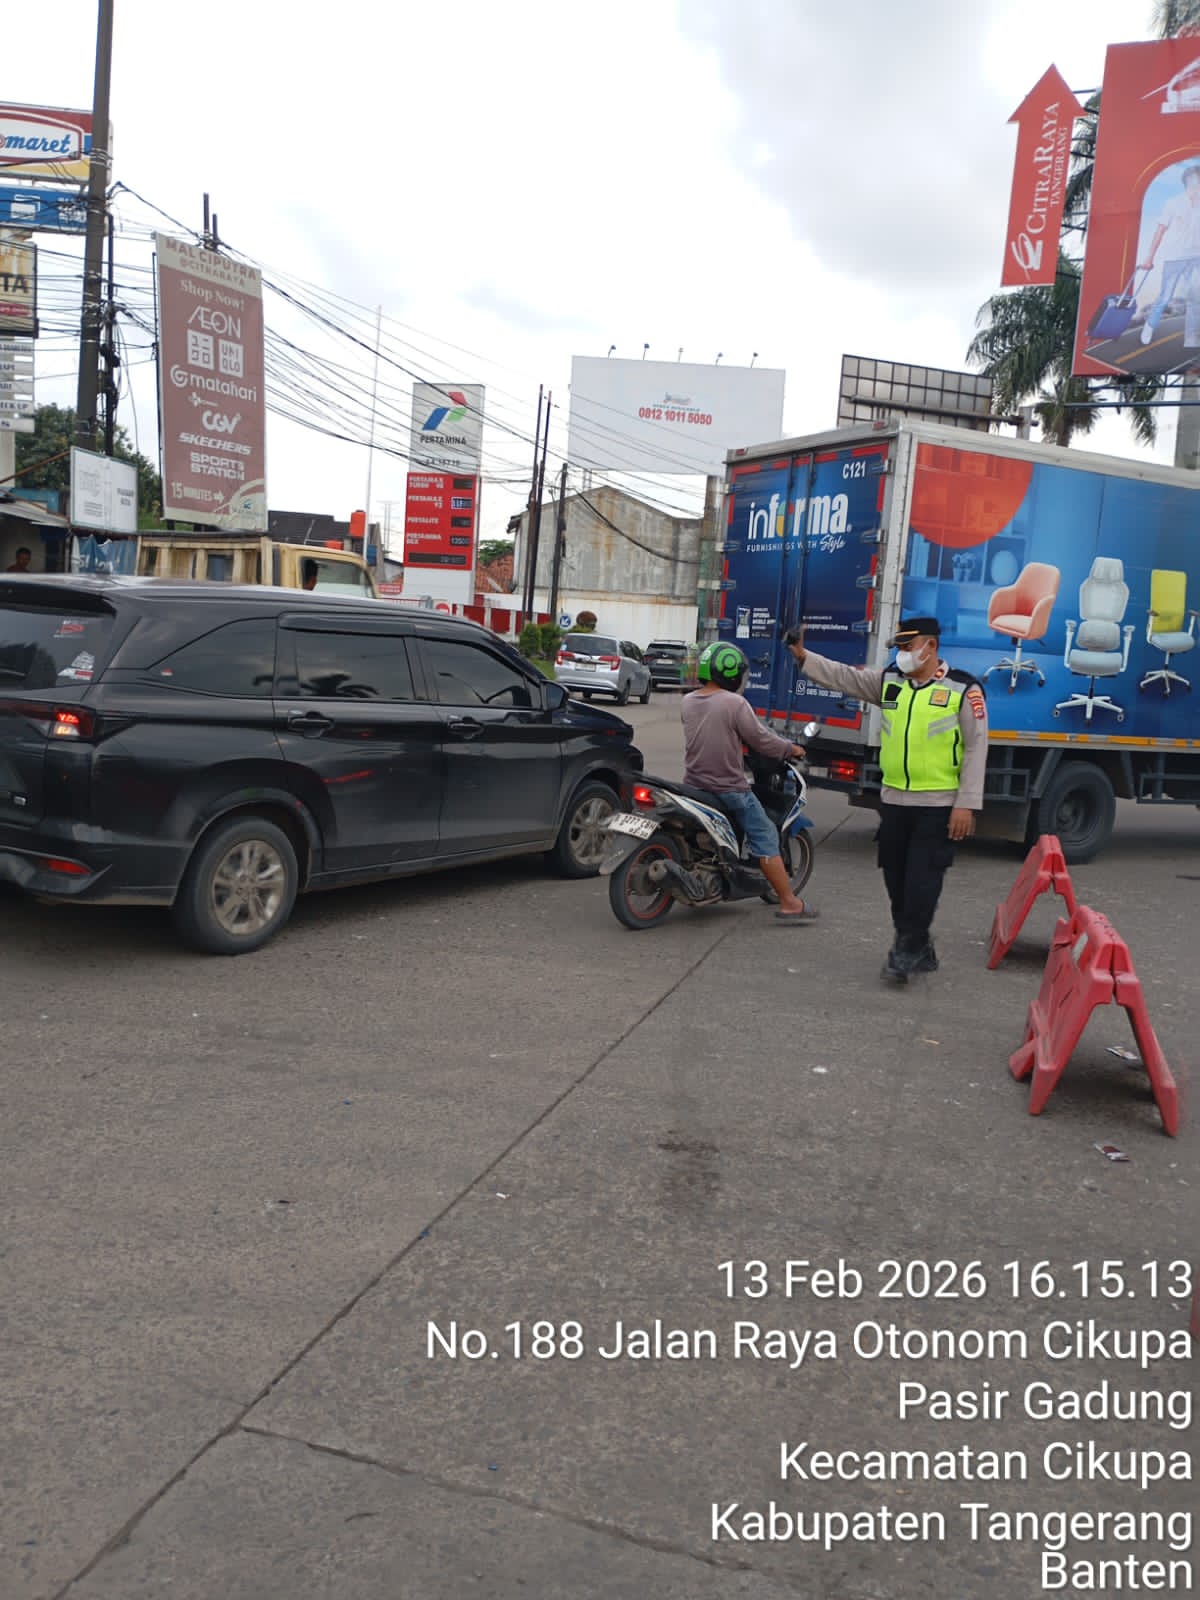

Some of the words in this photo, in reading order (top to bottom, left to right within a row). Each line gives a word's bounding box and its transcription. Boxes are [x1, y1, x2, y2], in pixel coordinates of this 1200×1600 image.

[1050, 127, 1068, 207] TANGERANG
[166, 239, 196, 258] MAL
[198, 252, 257, 280] CIPUTRA
[180, 280, 213, 300] Shop
[215, 289, 245, 312] Now!
[189, 374, 257, 402] matahari
[202, 410, 242, 434] CGV
[639, 407, 663, 420] 0812
[665, 410, 686, 422] 1011
[687, 412, 712, 425] 5050
[179, 432, 252, 455] SKECHERS
[420, 435, 466, 445] PERTAMINA
[190, 452, 245, 470] SPORTS
[842, 461, 867, 479] C121
[190, 463, 245, 481] STATION
[171, 482, 184, 499] 15
[820, 534, 846, 553] Style
